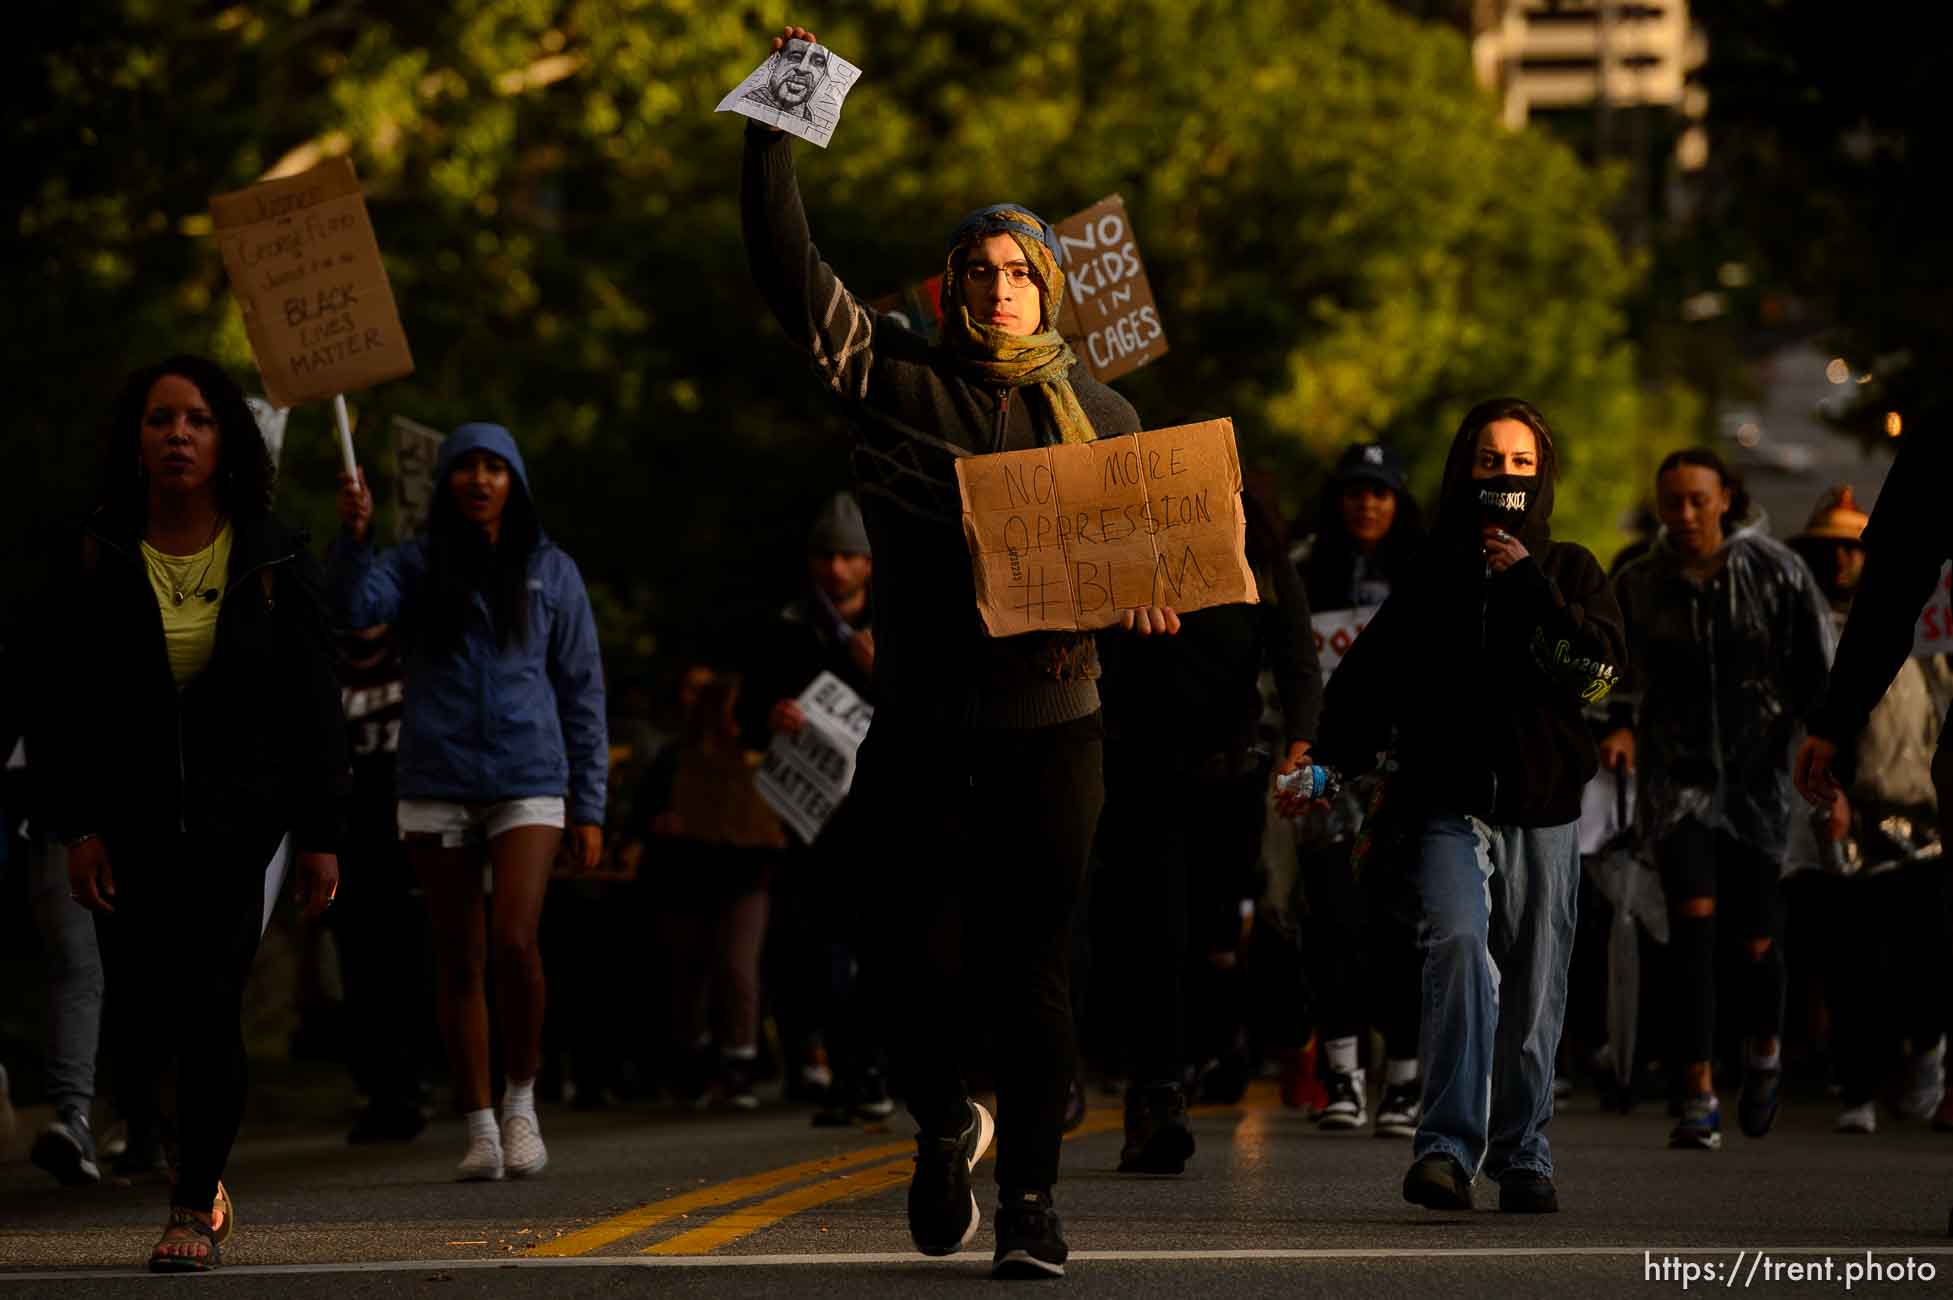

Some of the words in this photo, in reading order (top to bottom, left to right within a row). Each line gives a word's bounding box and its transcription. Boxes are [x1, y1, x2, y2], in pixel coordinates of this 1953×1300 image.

[1059, 215, 1123, 262] NO
[283, 281, 359, 327] BLACK
[1098, 283, 1131, 316] IN
[288, 326, 385, 378] MATTER
[300, 317, 356, 348] LIVES
[1087, 305, 1161, 369] CAGES
[1003, 463, 1054, 506] NO
[1102, 447, 1188, 492] MORE
[1003, 488, 1212, 558] OPPRESSION
